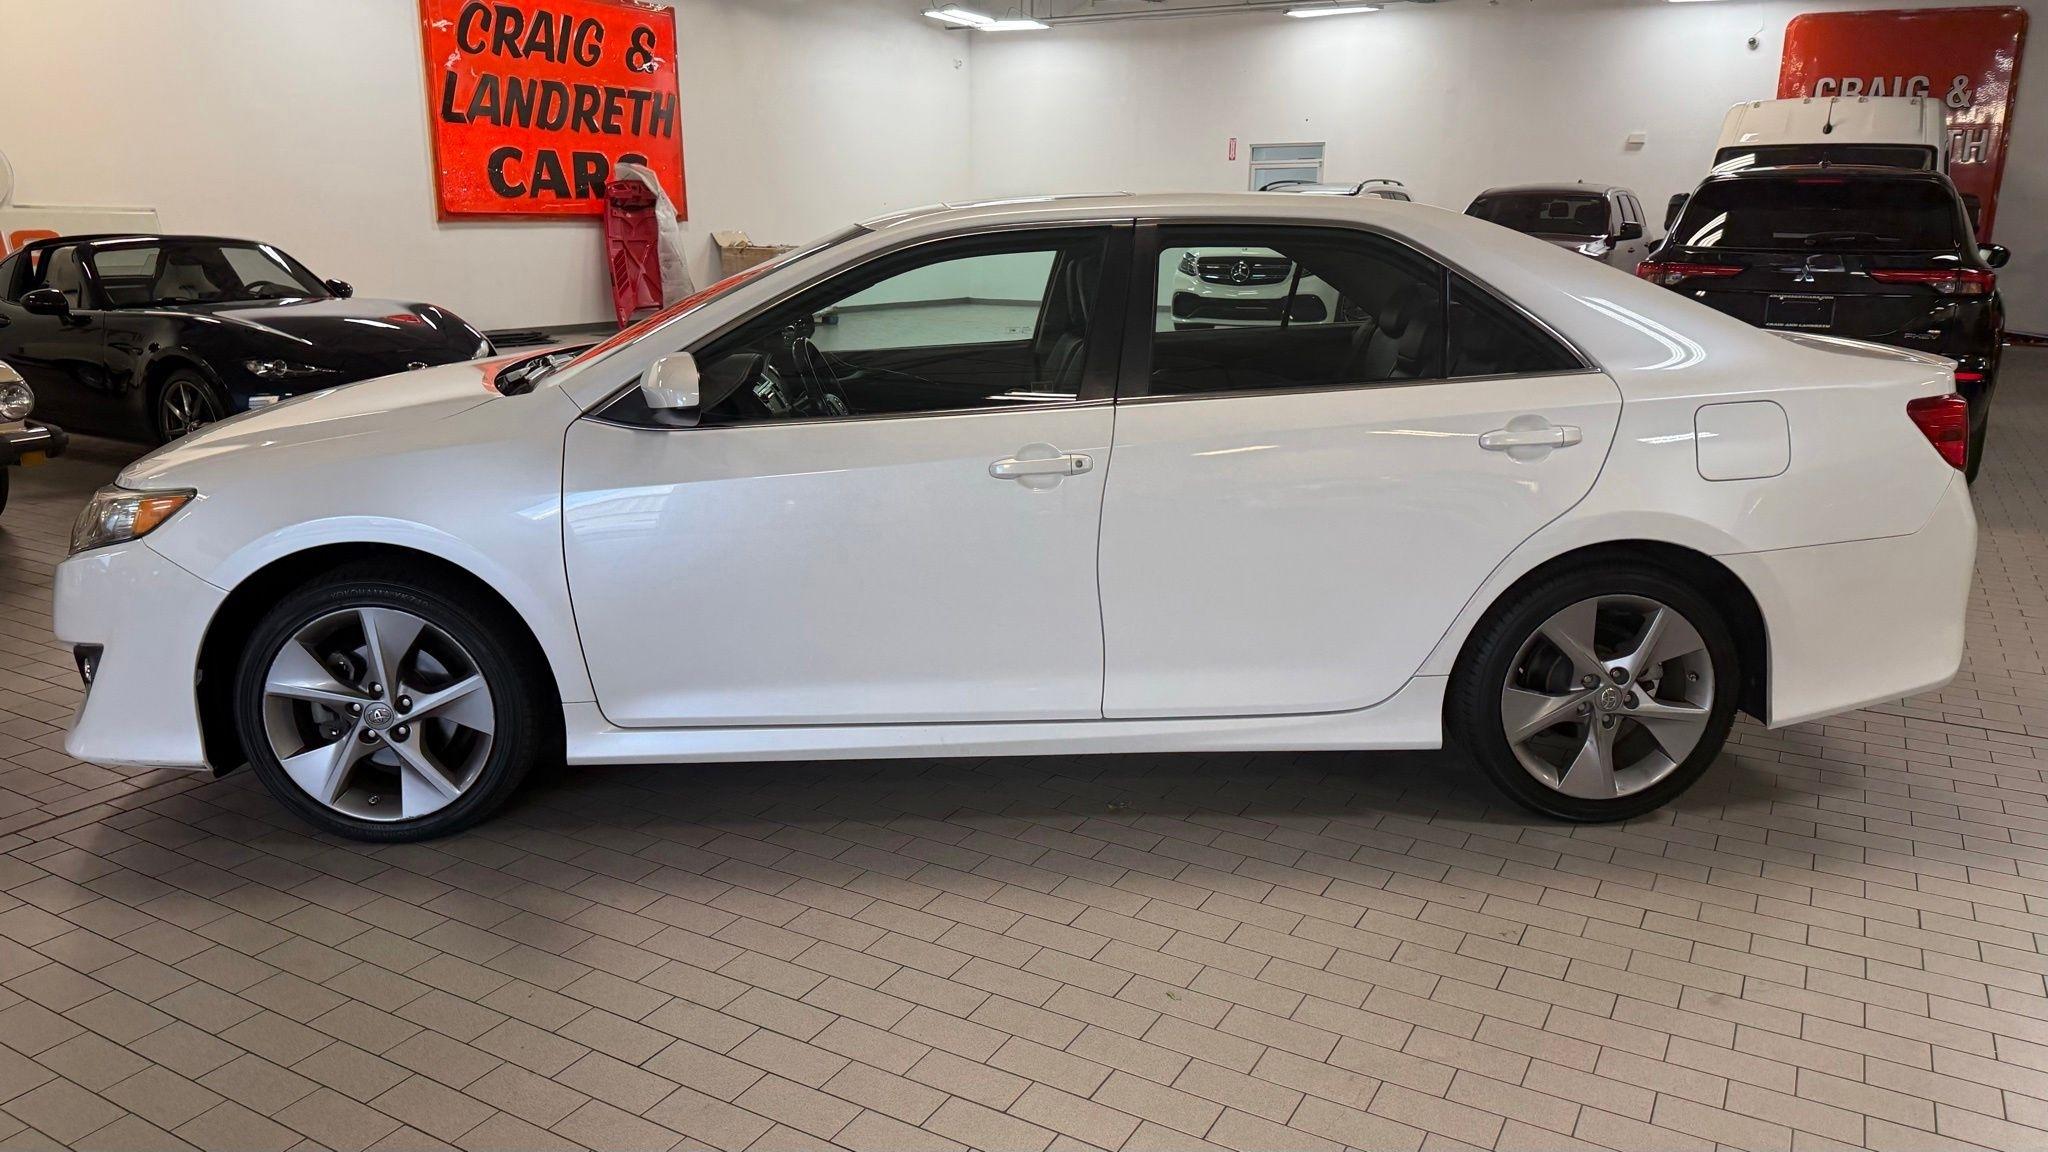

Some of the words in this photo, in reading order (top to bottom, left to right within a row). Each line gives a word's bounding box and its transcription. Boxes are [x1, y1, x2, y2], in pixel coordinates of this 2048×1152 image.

[456, 2, 605, 68] CRAIG
[625, 25, 656, 74] &
[441, 70, 676, 138] LANDRETH
[1814, 75, 1930, 98] CRAIG
[1946, 75, 1973, 109] &
[487, 146, 649, 200] CAR
